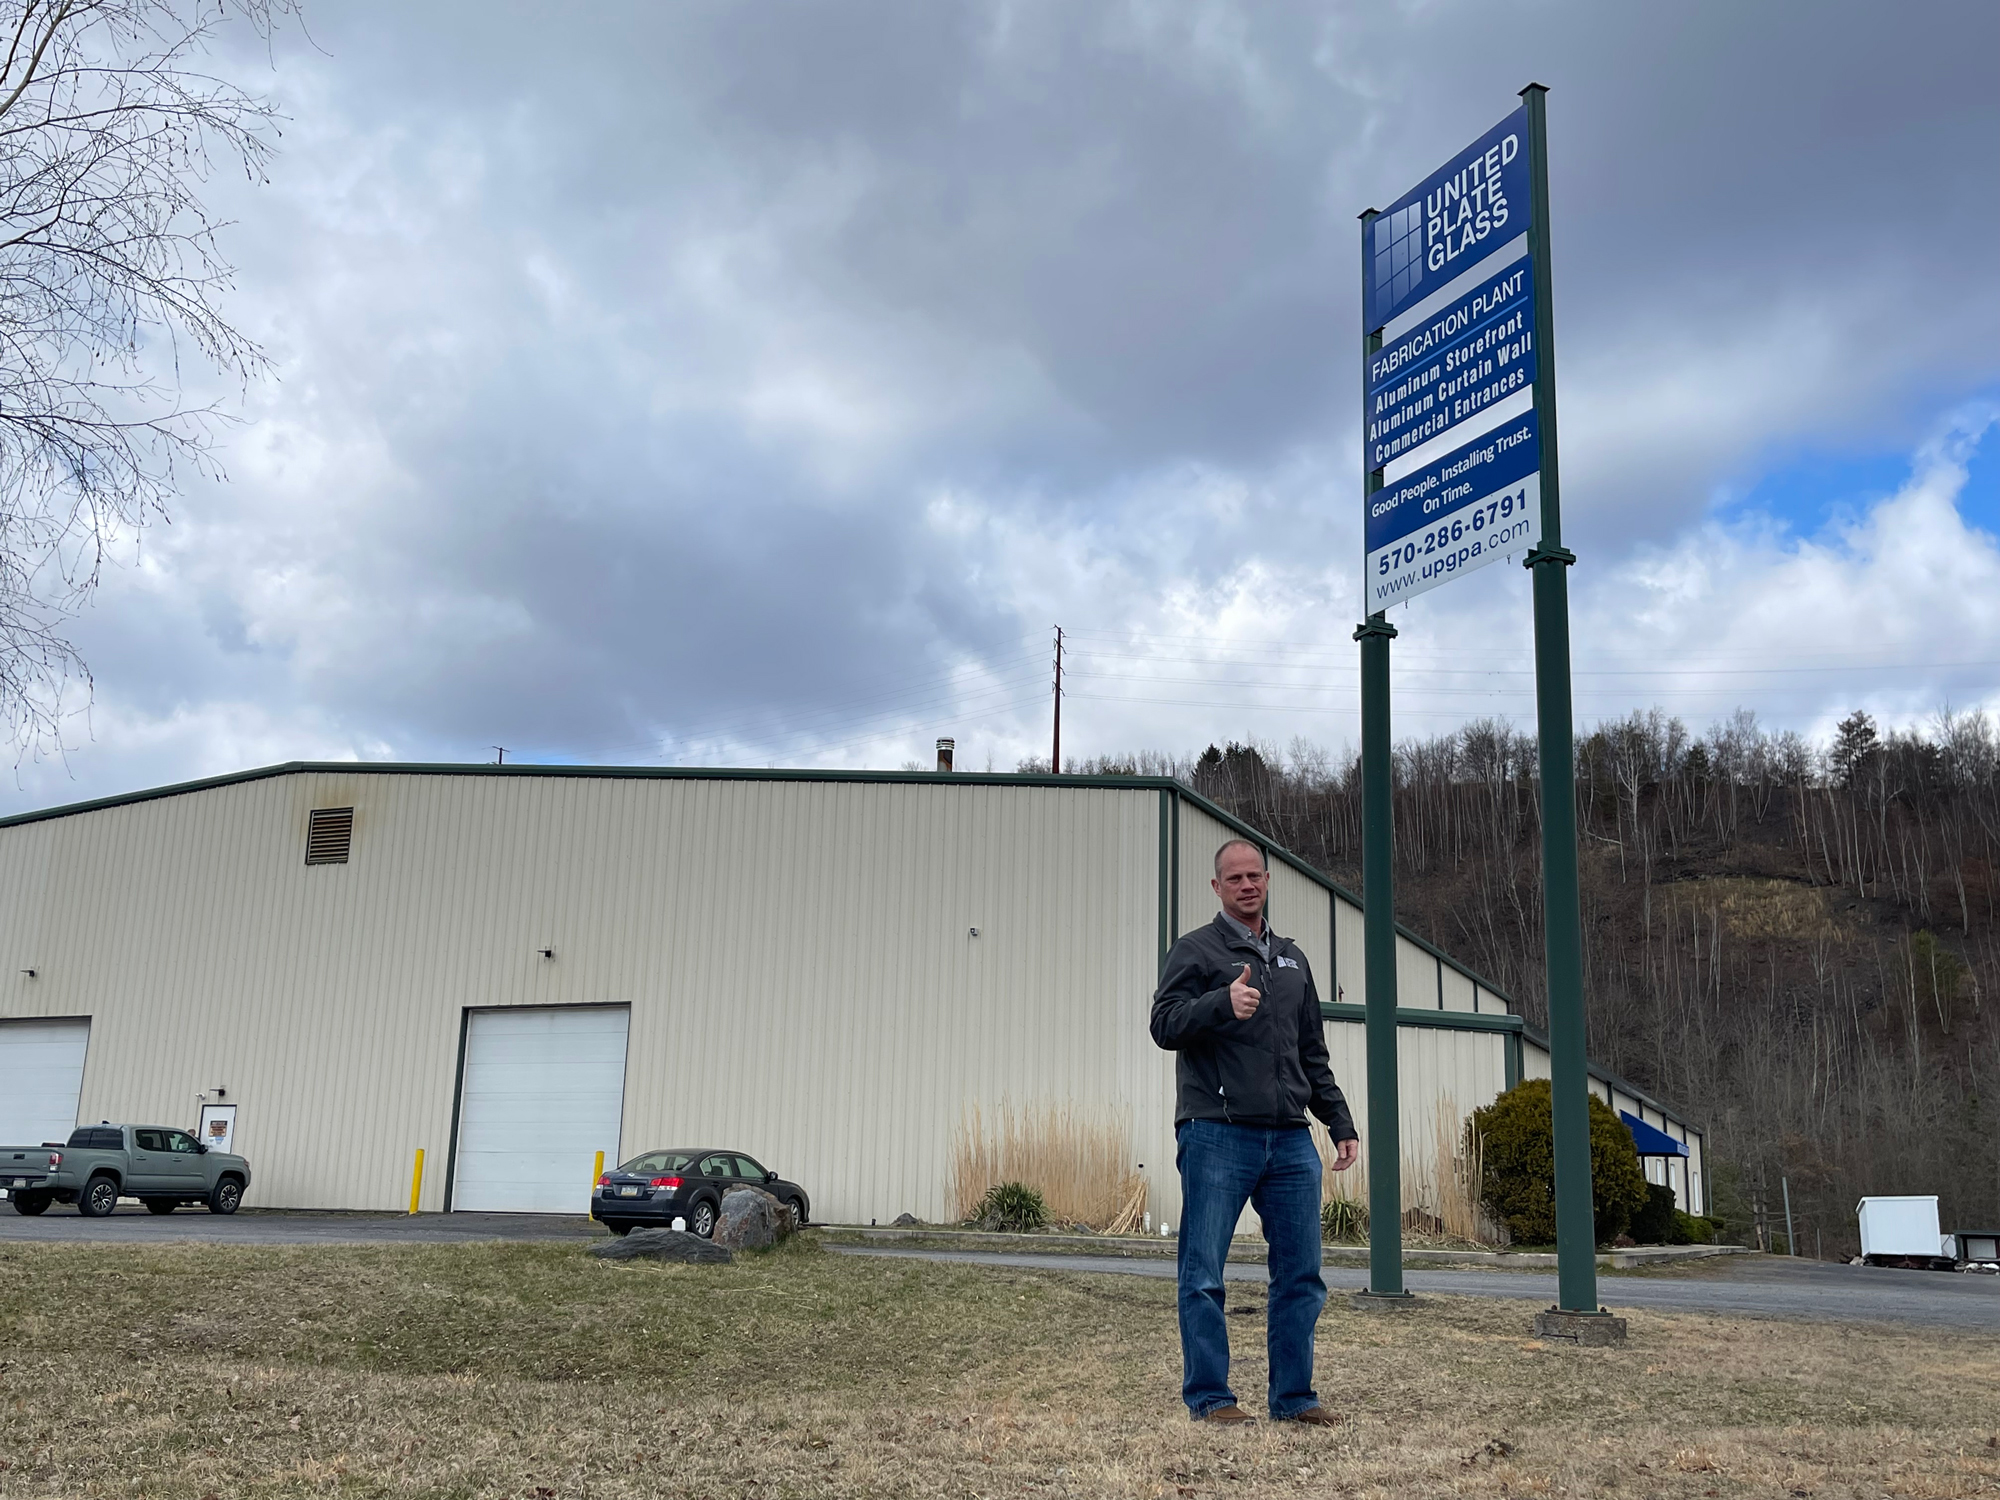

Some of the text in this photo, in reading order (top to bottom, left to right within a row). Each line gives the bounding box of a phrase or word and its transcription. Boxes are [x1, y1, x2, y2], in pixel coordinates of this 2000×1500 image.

[1427, 134, 1518, 218] UNITED
[1428, 171, 1502, 247] PLATE
[1428, 198, 1508, 271] GLASS
[1372, 270, 1524, 382] FABRICATION PLANT
[1376, 311, 1522, 414] Aluminum Storefront
[1370, 331, 1531, 442] Aluminum Curtain Wall
[1376, 368, 1524, 462] Commercial Entrances
[1372, 426, 1532, 518] Good People. Installing Trust.
[1423, 482, 1473, 514] On Time.
[1376, 519, 1530, 599] www.upgpa.com
[1379, 488, 1526, 576] 570-286-6791
